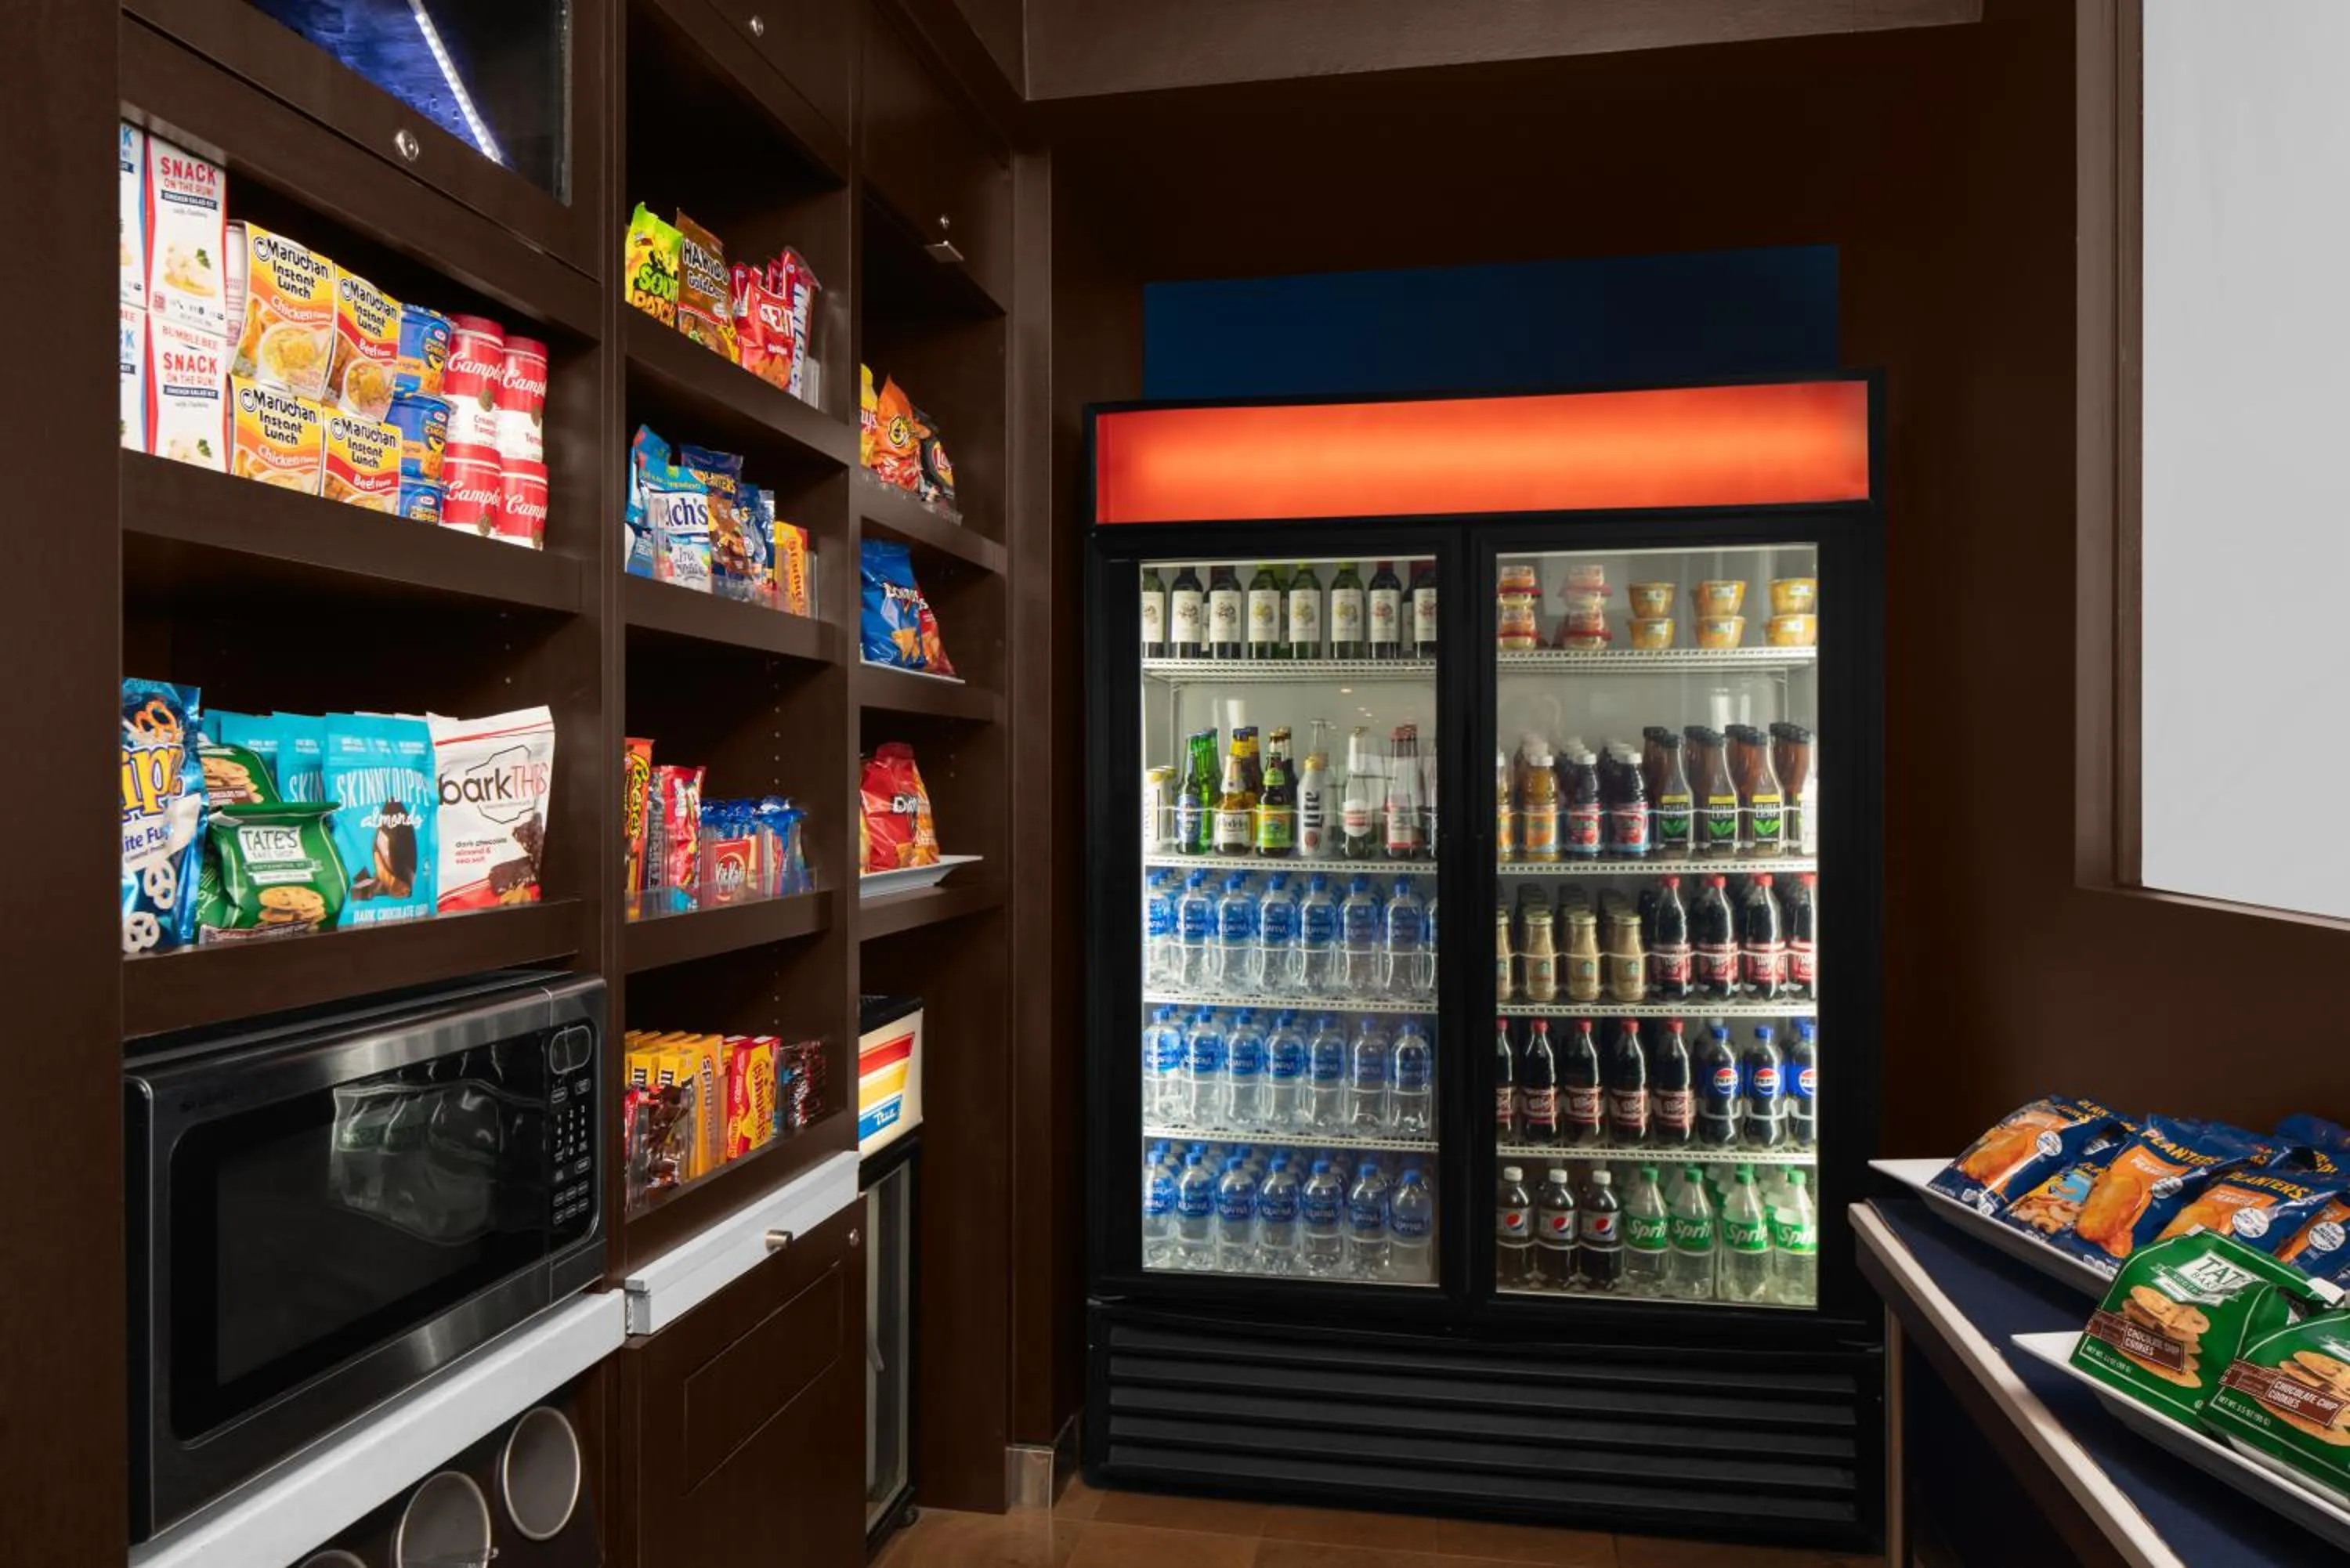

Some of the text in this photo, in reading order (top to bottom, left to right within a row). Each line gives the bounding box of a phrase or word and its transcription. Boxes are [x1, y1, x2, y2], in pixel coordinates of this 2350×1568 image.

[161, 156, 216, 185] SNACK
[267, 238, 328, 280] Maruchan
[273, 259, 316, 289] Instant
[277, 275, 311, 300] Lunch
[350, 280, 397, 320] Maruchan
[353, 301, 386, 327] Instant
[162, 325, 218, 349] BUMBLE BEE
[357, 315, 381, 338] Lunch
[358, 338, 377, 356] Beef
[163, 352, 216, 376] SNACK
[253, 388, 317, 423] Maruchan
[259, 410, 302, 434] Instant
[342, 418, 396, 447] Maruchan
[264, 425, 298, 446] Lunch
[257, 444, 301, 467] Chicken
[347, 439, 383, 458] Instant
[351, 450, 379, 468] Lunch
[353, 474, 375, 489] Beef
[627, 753, 651, 840] Reese's
[240, 829, 298, 851] TATE'S
[455, 837, 508, 848] dark chocolate
[454, 848, 485, 857] almond
[2124, 1337, 2154, 1357] COOKIES
[2127, 1327, 2163, 1349] CHOCOLATE
[2267, 1389, 2301, 1409] COOKIES
[2273, 1380, 2339, 1411] CHOCOLATE CHIP
